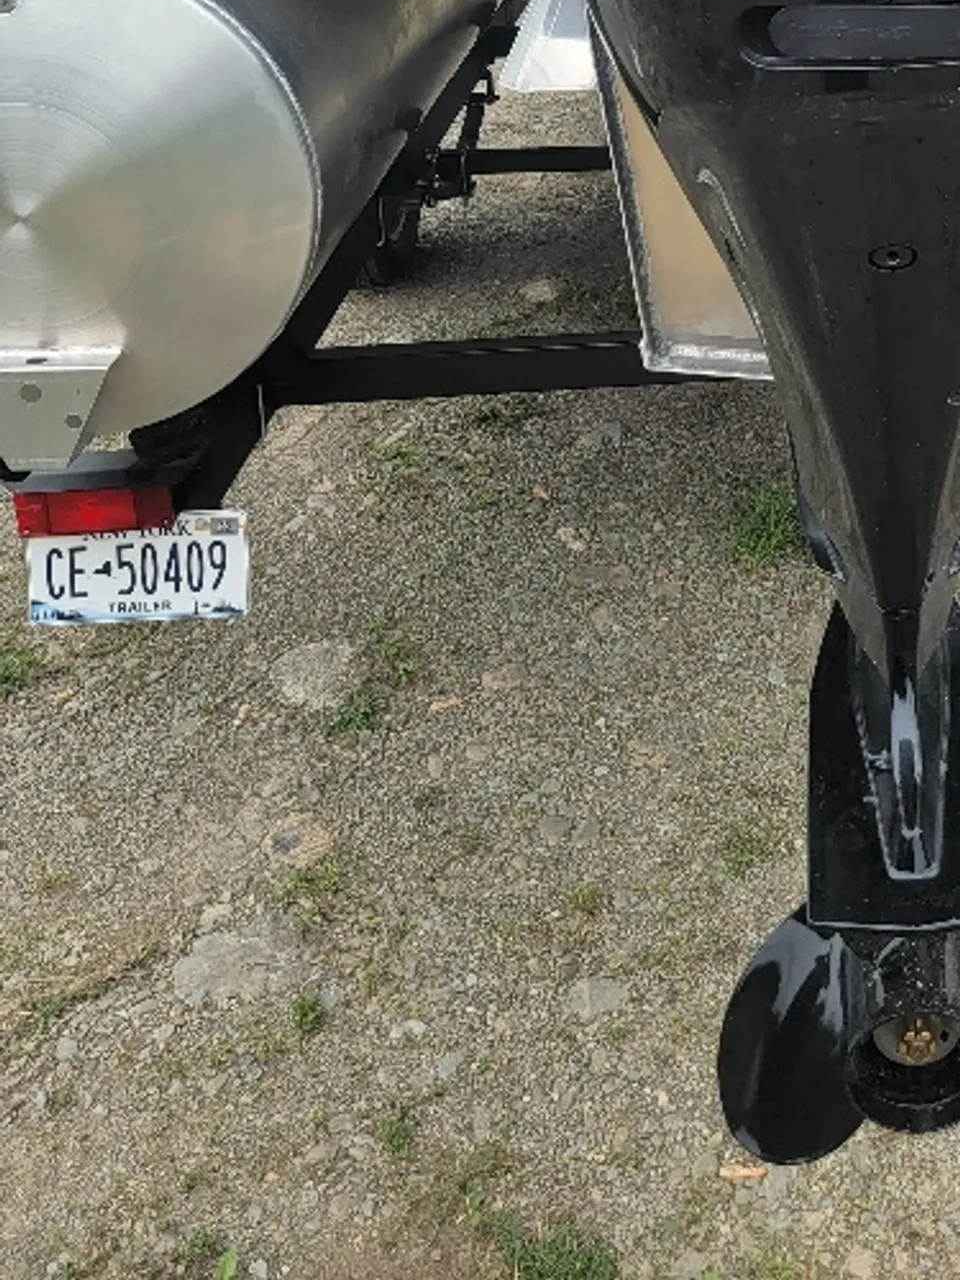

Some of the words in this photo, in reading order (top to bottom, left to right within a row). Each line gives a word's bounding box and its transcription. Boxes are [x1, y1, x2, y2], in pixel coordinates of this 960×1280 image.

[46, 546, 89, 600] CE
[116, 540, 227, 596] 50409
[108, 599, 173, 614] TRAILER
